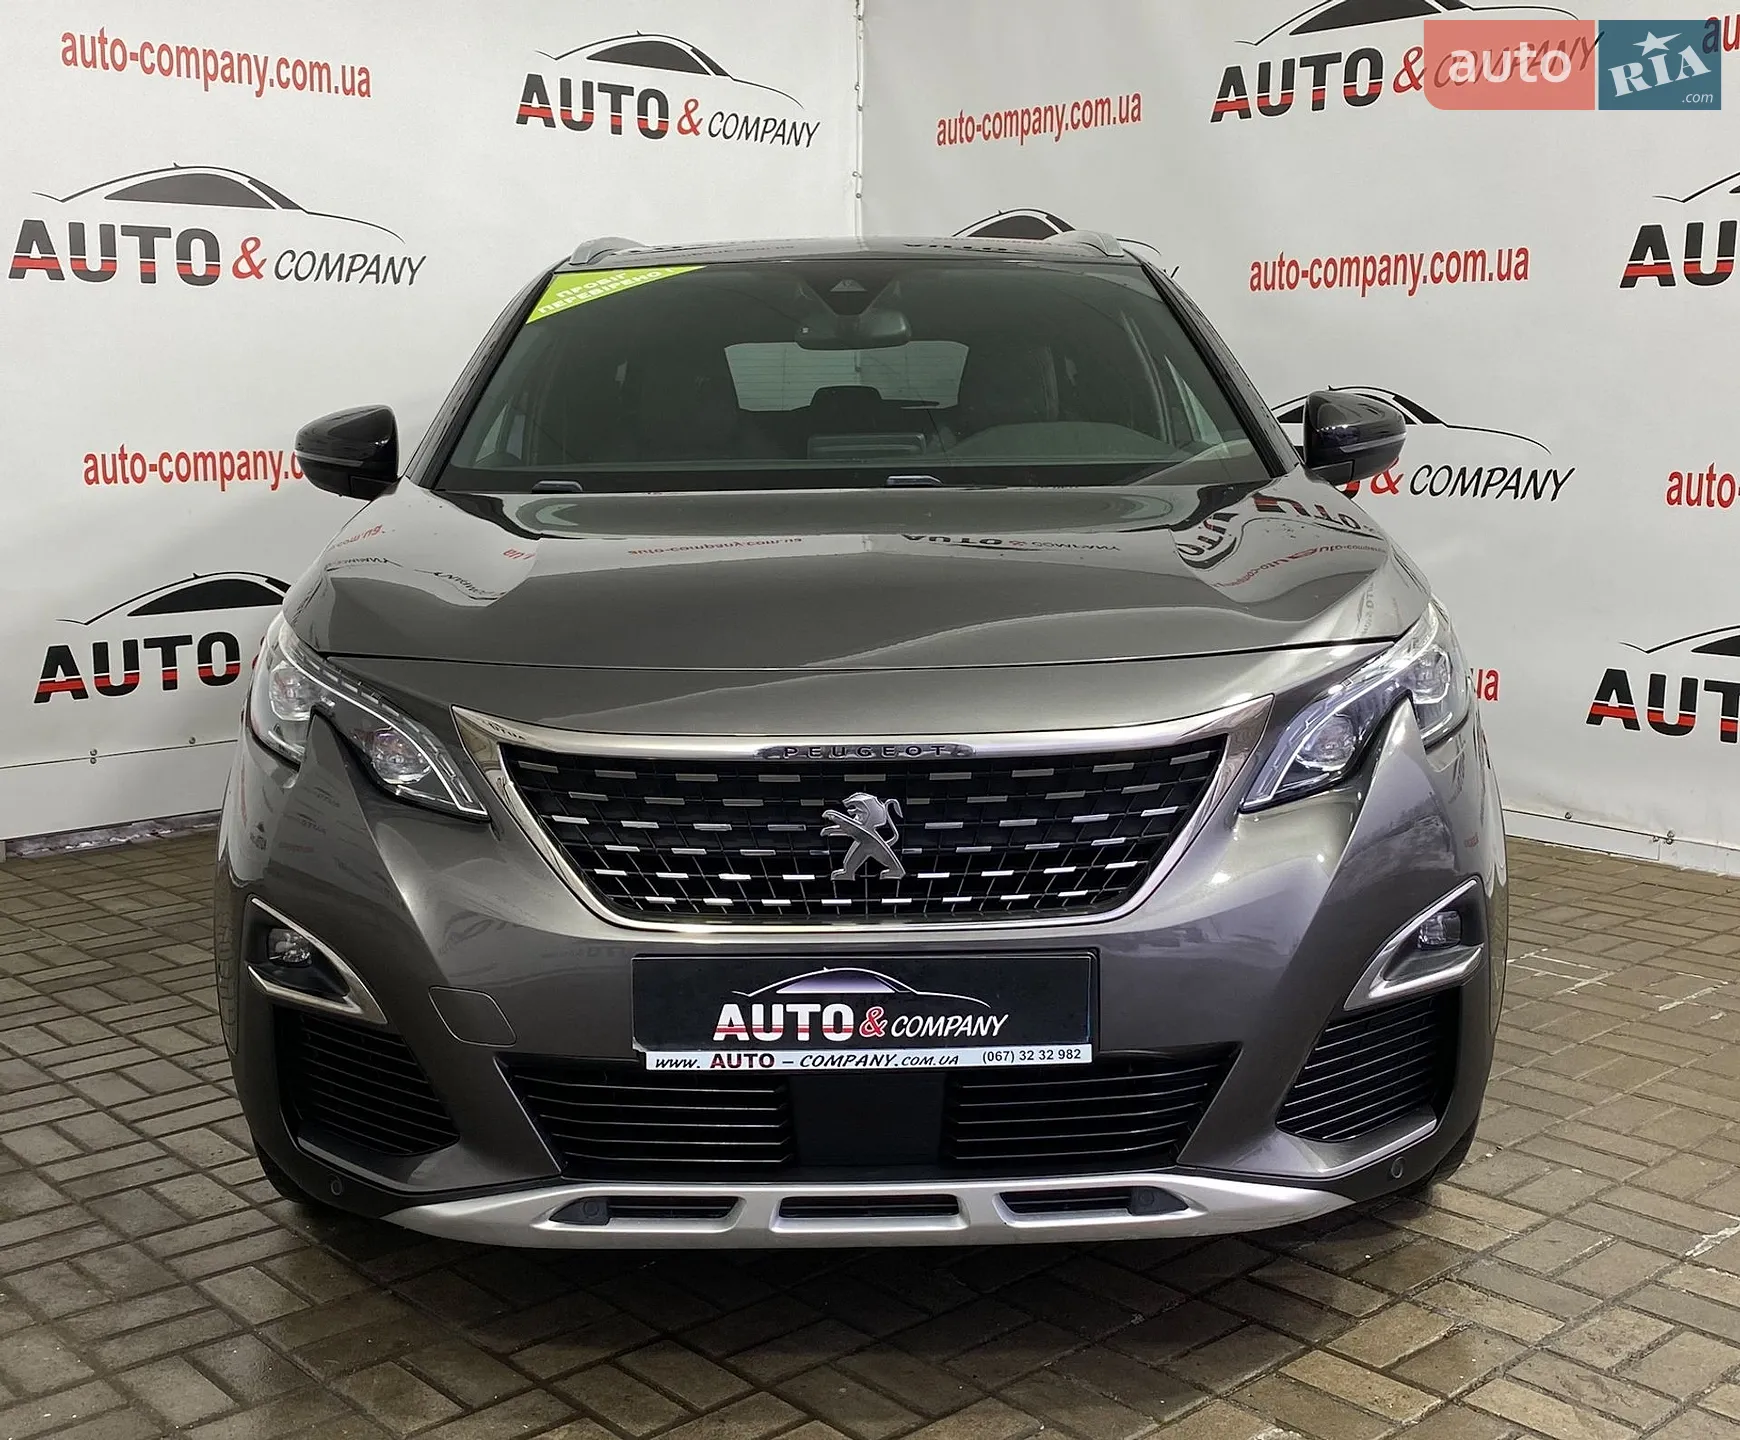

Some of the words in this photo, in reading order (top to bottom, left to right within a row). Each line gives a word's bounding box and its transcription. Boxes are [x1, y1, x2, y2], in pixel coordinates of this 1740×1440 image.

[61, 27, 371, 97] auto-company.com.ua
[1210, 48, 1384, 123] AUTO
[1393, 46, 1427, 92] &
[516, 73, 670, 139] AUTO
[677, 98, 704, 137] &
[708, 111, 820, 148] COMPANY
[936, 92, 1142, 145] auto-company.com.ua
[8, 219, 221, 287] AUTO
[231, 236, 267, 280] &
[274, 249, 426, 286] COMPANY
[1250, 247, 1530, 298] auto-company.com.ua
[1409, 464, 1576, 502] COMPANY
[33, 631, 241, 704] AUTO
[783, 744, 946, 759] PEUGEOT
[712, 1004, 854, 1041] AUTO
[859, 1006, 889, 1038] &
[890, 1013, 1010, 1038] COMPANY
[655, 1058, 701, 1069] www.
[709, 1053, 776, 1069] AUTO
[982, 1050, 1015, 1064] (067)
[1019, 1050, 1035, 1062] 32
[1038, 1049, 1054, 1061] 32
[1057, 1048, 1082, 1061] 982
